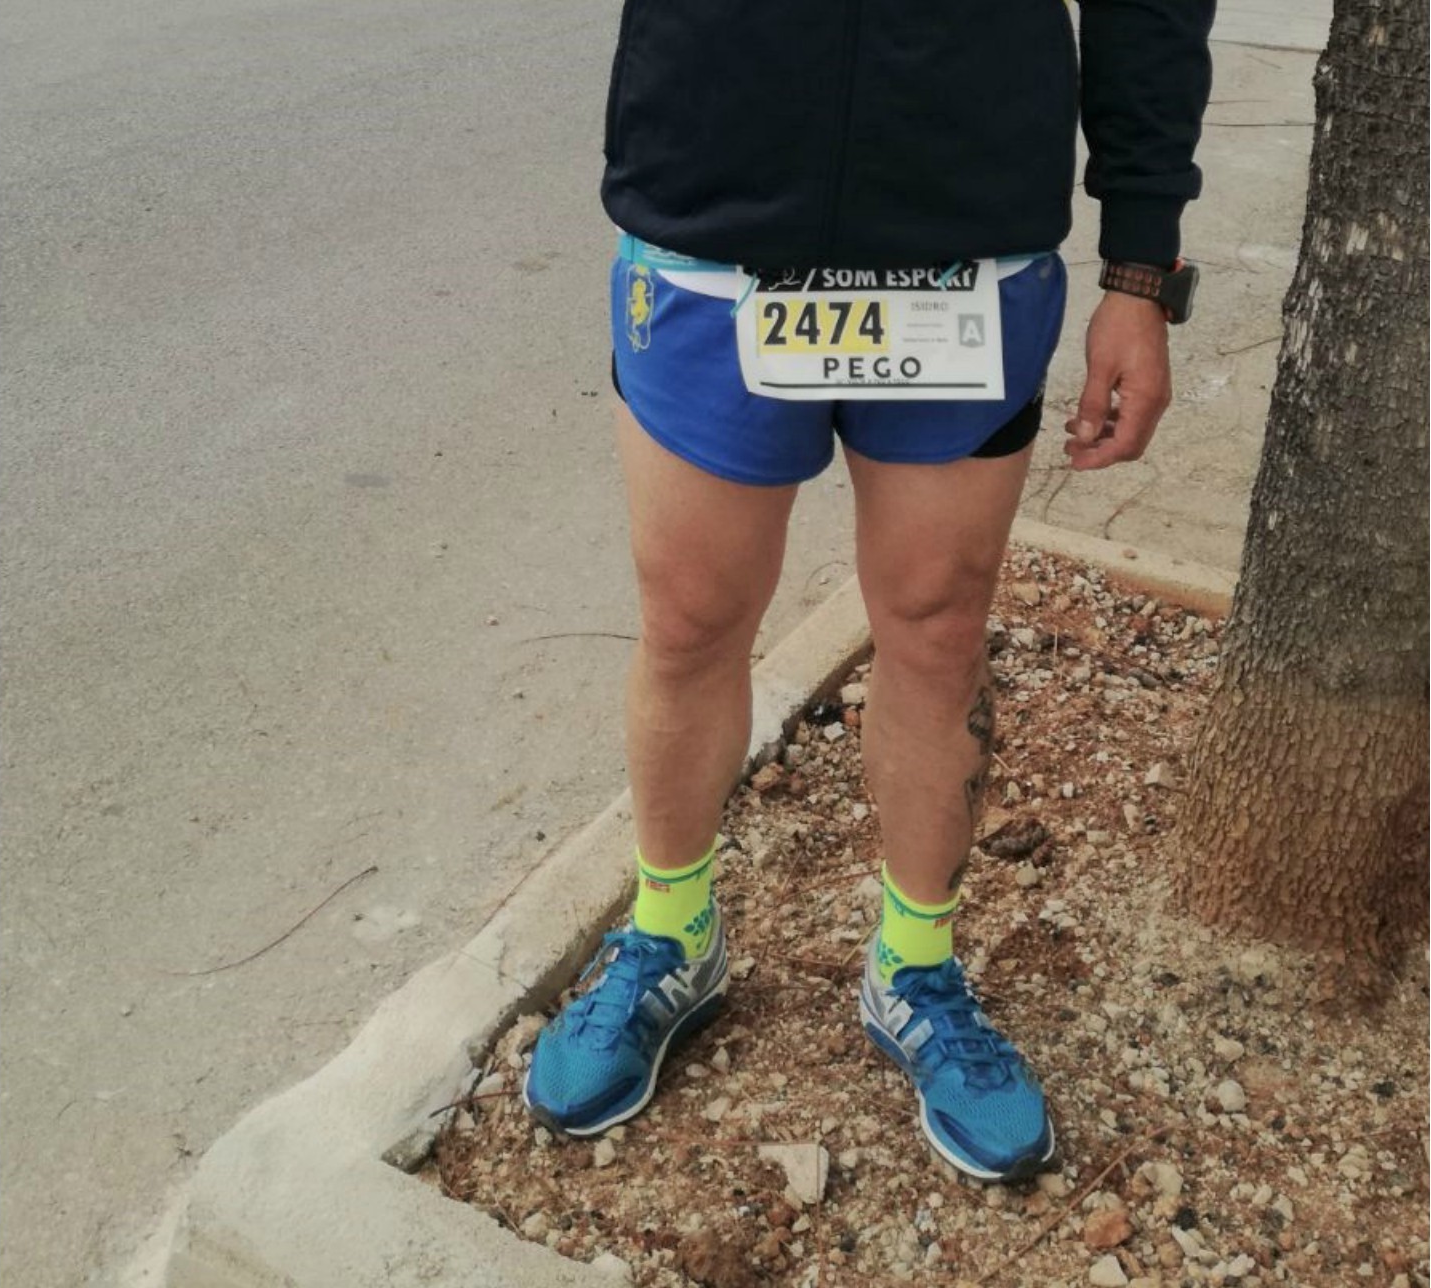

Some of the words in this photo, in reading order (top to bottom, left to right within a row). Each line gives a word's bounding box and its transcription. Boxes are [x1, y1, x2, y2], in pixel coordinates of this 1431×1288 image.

[822, 268, 877, 289] SOM
[763, 301, 885, 346] 2474
[961, 319, 983, 343] A
[823, 356, 922, 379] PEGO
